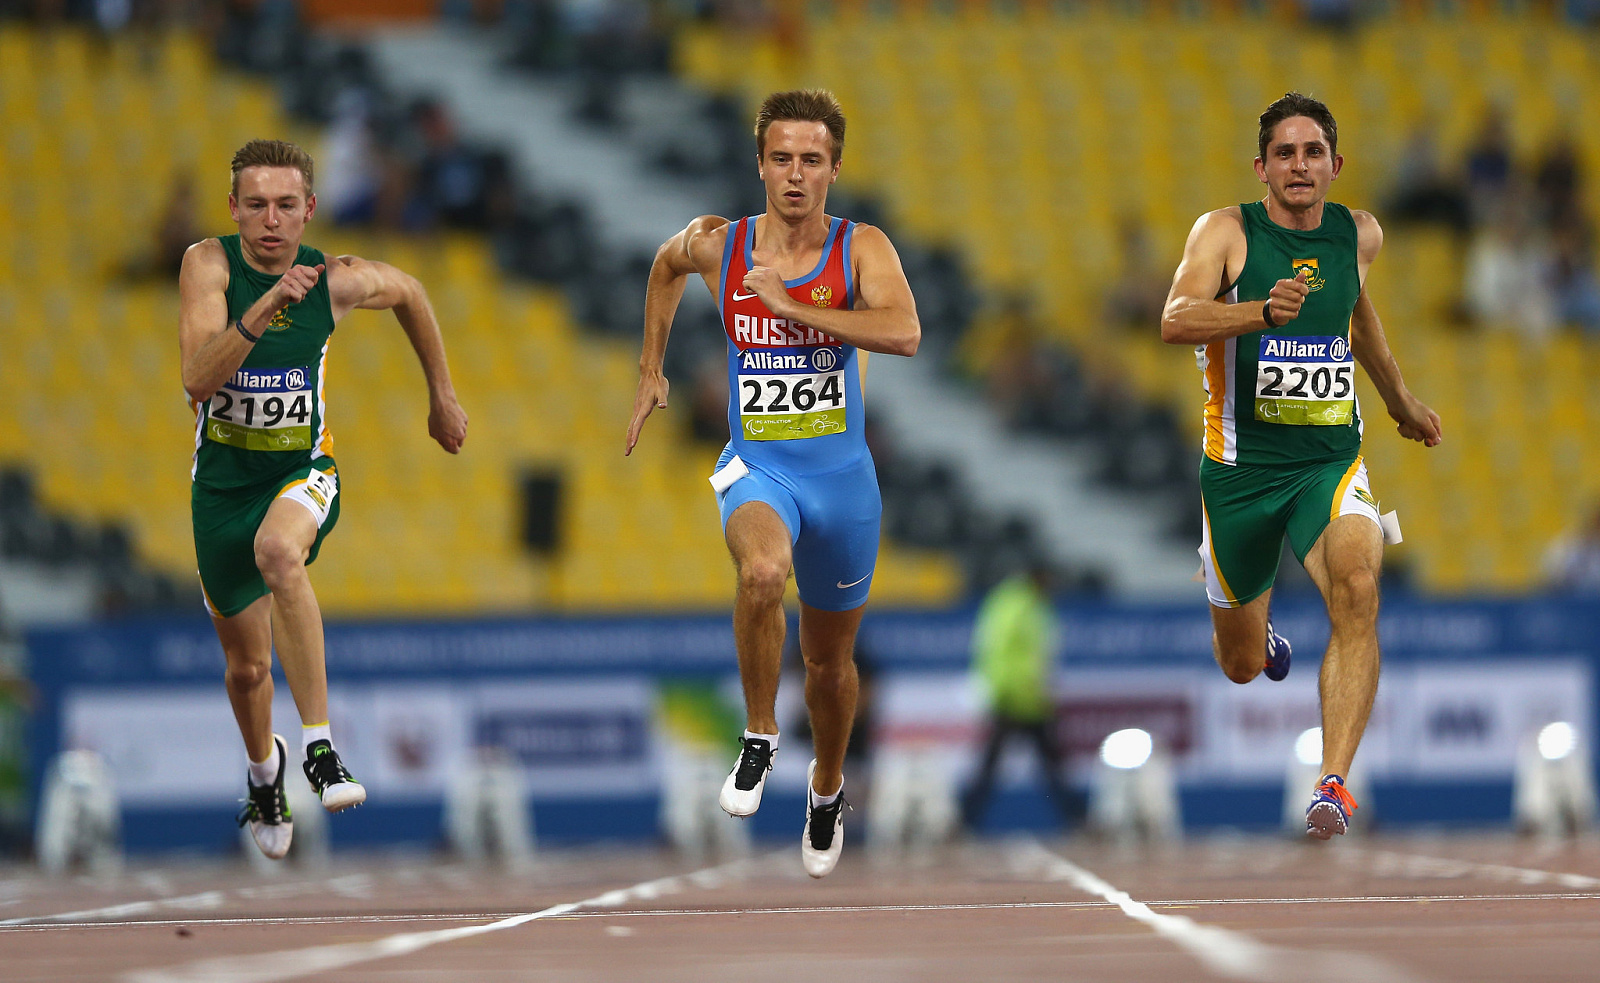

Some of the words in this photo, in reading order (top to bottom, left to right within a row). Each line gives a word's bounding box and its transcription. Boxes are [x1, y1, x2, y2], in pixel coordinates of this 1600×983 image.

[742, 352, 808, 370] Allianz
[1264, 339, 1327, 358] Allianz
[228, 371, 282, 389] llianz
[1260, 366, 1351, 399] 2205
[742, 375, 843, 413] 2264
[212, 390, 309, 427] 2194
